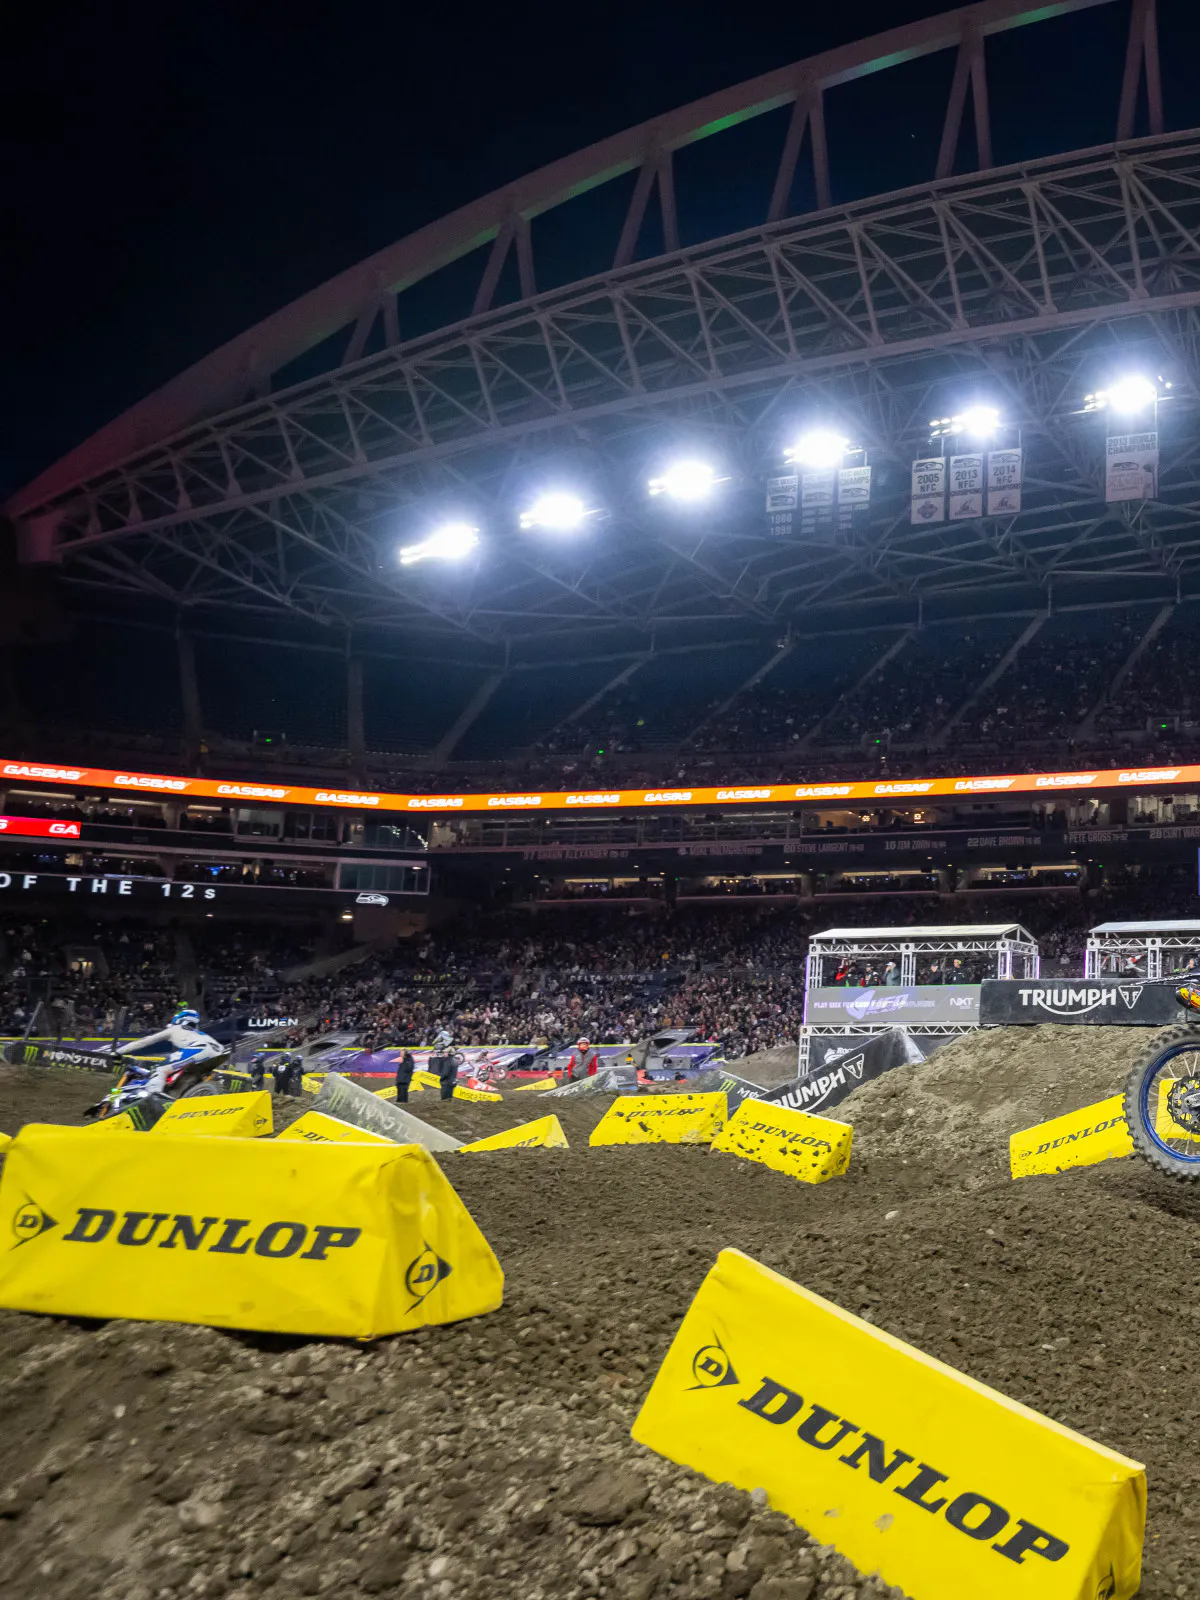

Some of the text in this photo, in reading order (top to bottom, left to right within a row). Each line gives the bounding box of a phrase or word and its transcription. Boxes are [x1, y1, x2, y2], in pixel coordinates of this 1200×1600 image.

[1108, 443, 1157, 456] CHAMPIONS
[955, 470, 978, 481] 2013
[994, 465, 1016, 476] 2014
[918, 473, 939, 484] 2005
[997, 475, 1013, 485] NFC
[920, 484, 936, 492] NFC
[958, 480, 976, 489] NFC
[4, 766, 82, 781] GASGAS
[115, 776, 186, 790] GASGAS
[218, 785, 287, 798] GASGAS
[717, 790, 770, 800] GASGAS
[796, 787, 851, 796] GASGAS
[316, 793, 379, 805] GASGAS
[408, 798, 463, 807] GASGAS
[488, 796, 541, 806] GASGAS
[566, 795, 619, 803] GASGAS
[49, 823, 80, 835] GA
[1162, 829, 1182, 839] CURT
[967, 836, 1024, 847] 22 DAVE BROWN
[1069, 834, 1086, 843] PETE
[1088, 833, 1111, 843] GROSS
[797, 842, 817, 853] STEVE
[885, 840, 896, 850] 10
[899, 840, 911, 850] JIM
[0, 873, 216, 899] OF THE 12s
[1018, 988, 1117, 1013] TRIUMPH
[248, 1017, 298, 1028] LUMEN
[43, 1050, 107, 1070] MONSTER
[771, 1068, 847, 1110] IUMPH
[178, 1106, 245, 1120] DUNLOP
[627, 1107, 706, 1118] DUNLOP
[749, 1122, 832, 1149] DUNLOP
[1035, 1115, 1125, 1155] DUNLOP
[62, 1207, 362, 1261] DUNLOP
[736, 1376, 1070, 1565] DUNLOP
